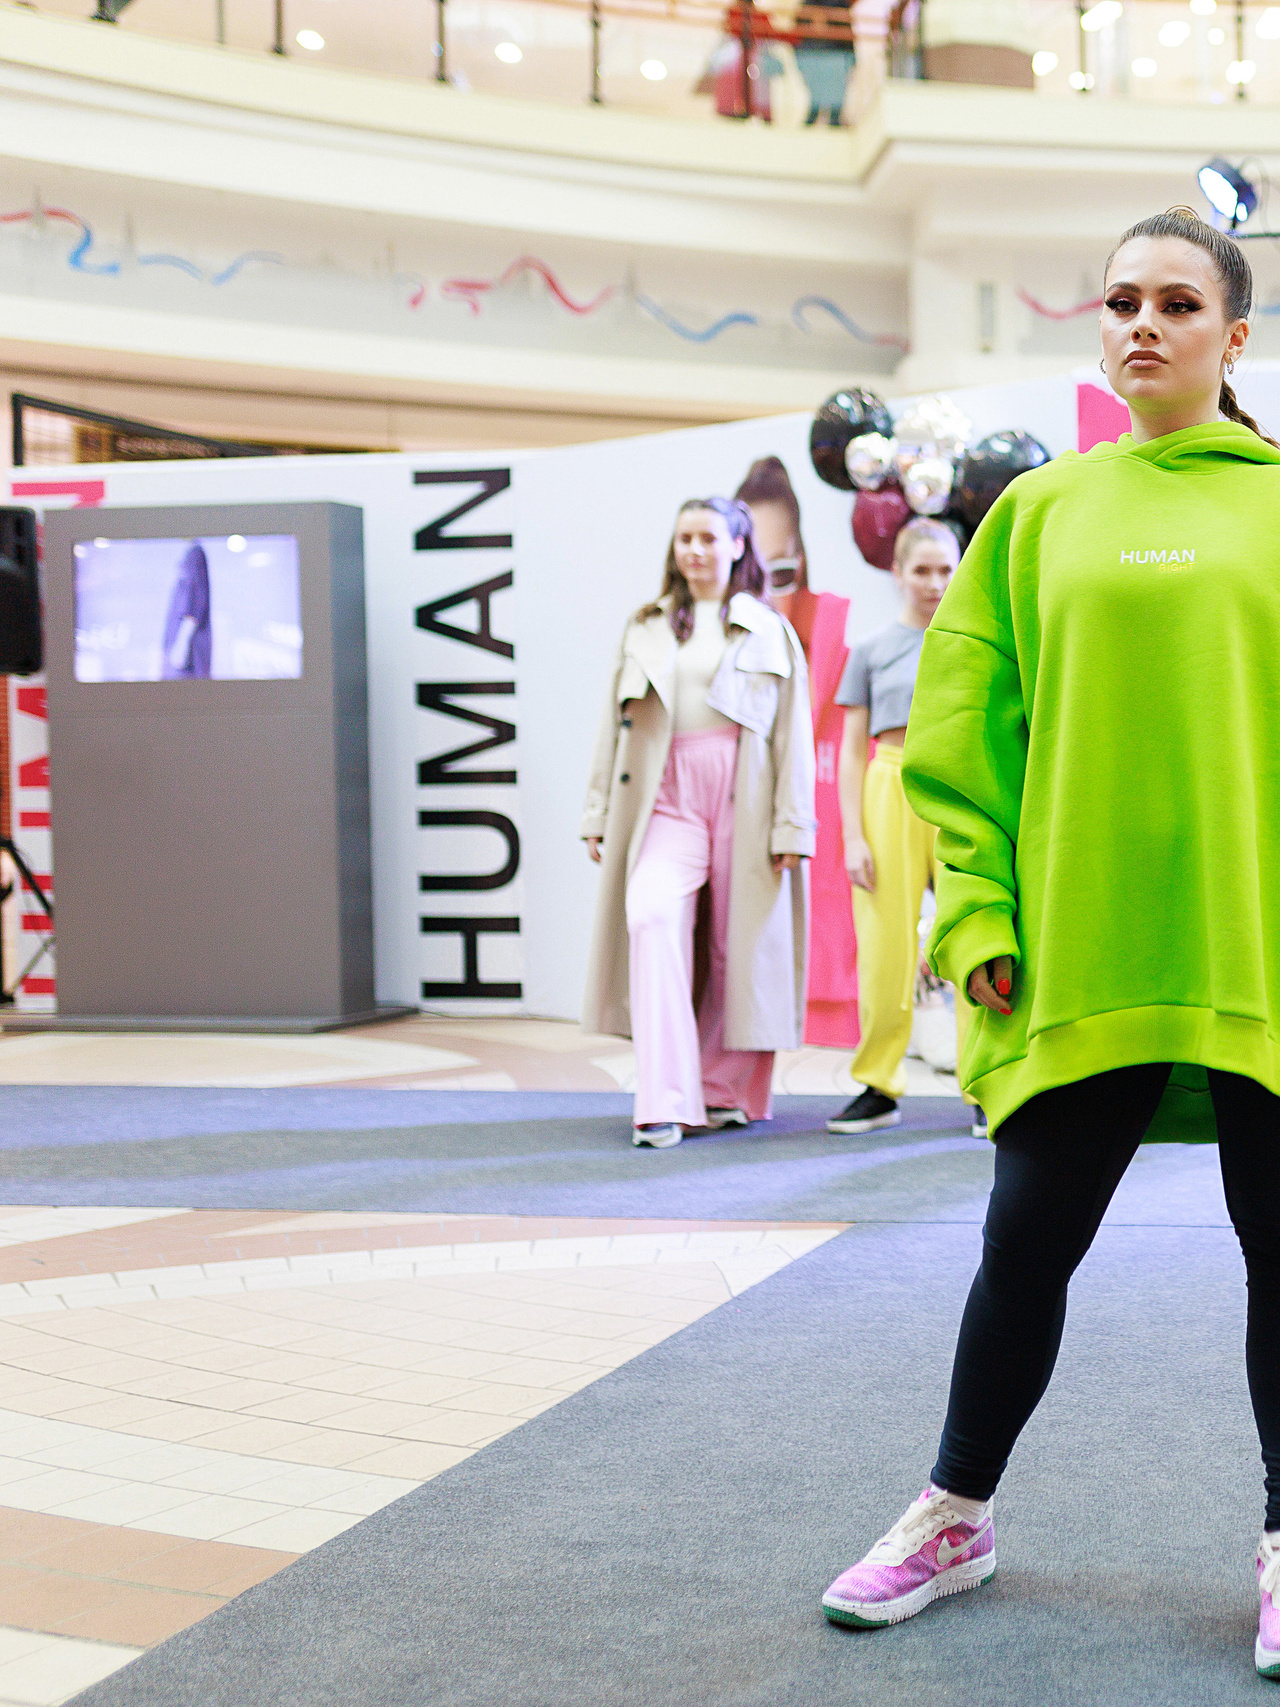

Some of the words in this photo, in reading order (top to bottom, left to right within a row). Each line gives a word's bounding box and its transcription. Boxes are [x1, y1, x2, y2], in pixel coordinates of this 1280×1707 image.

[1120, 549, 1195, 564] HUMAN
[1158, 562, 1195, 572] RIGHT
[412, 467, 522, 1001] HUMAN
